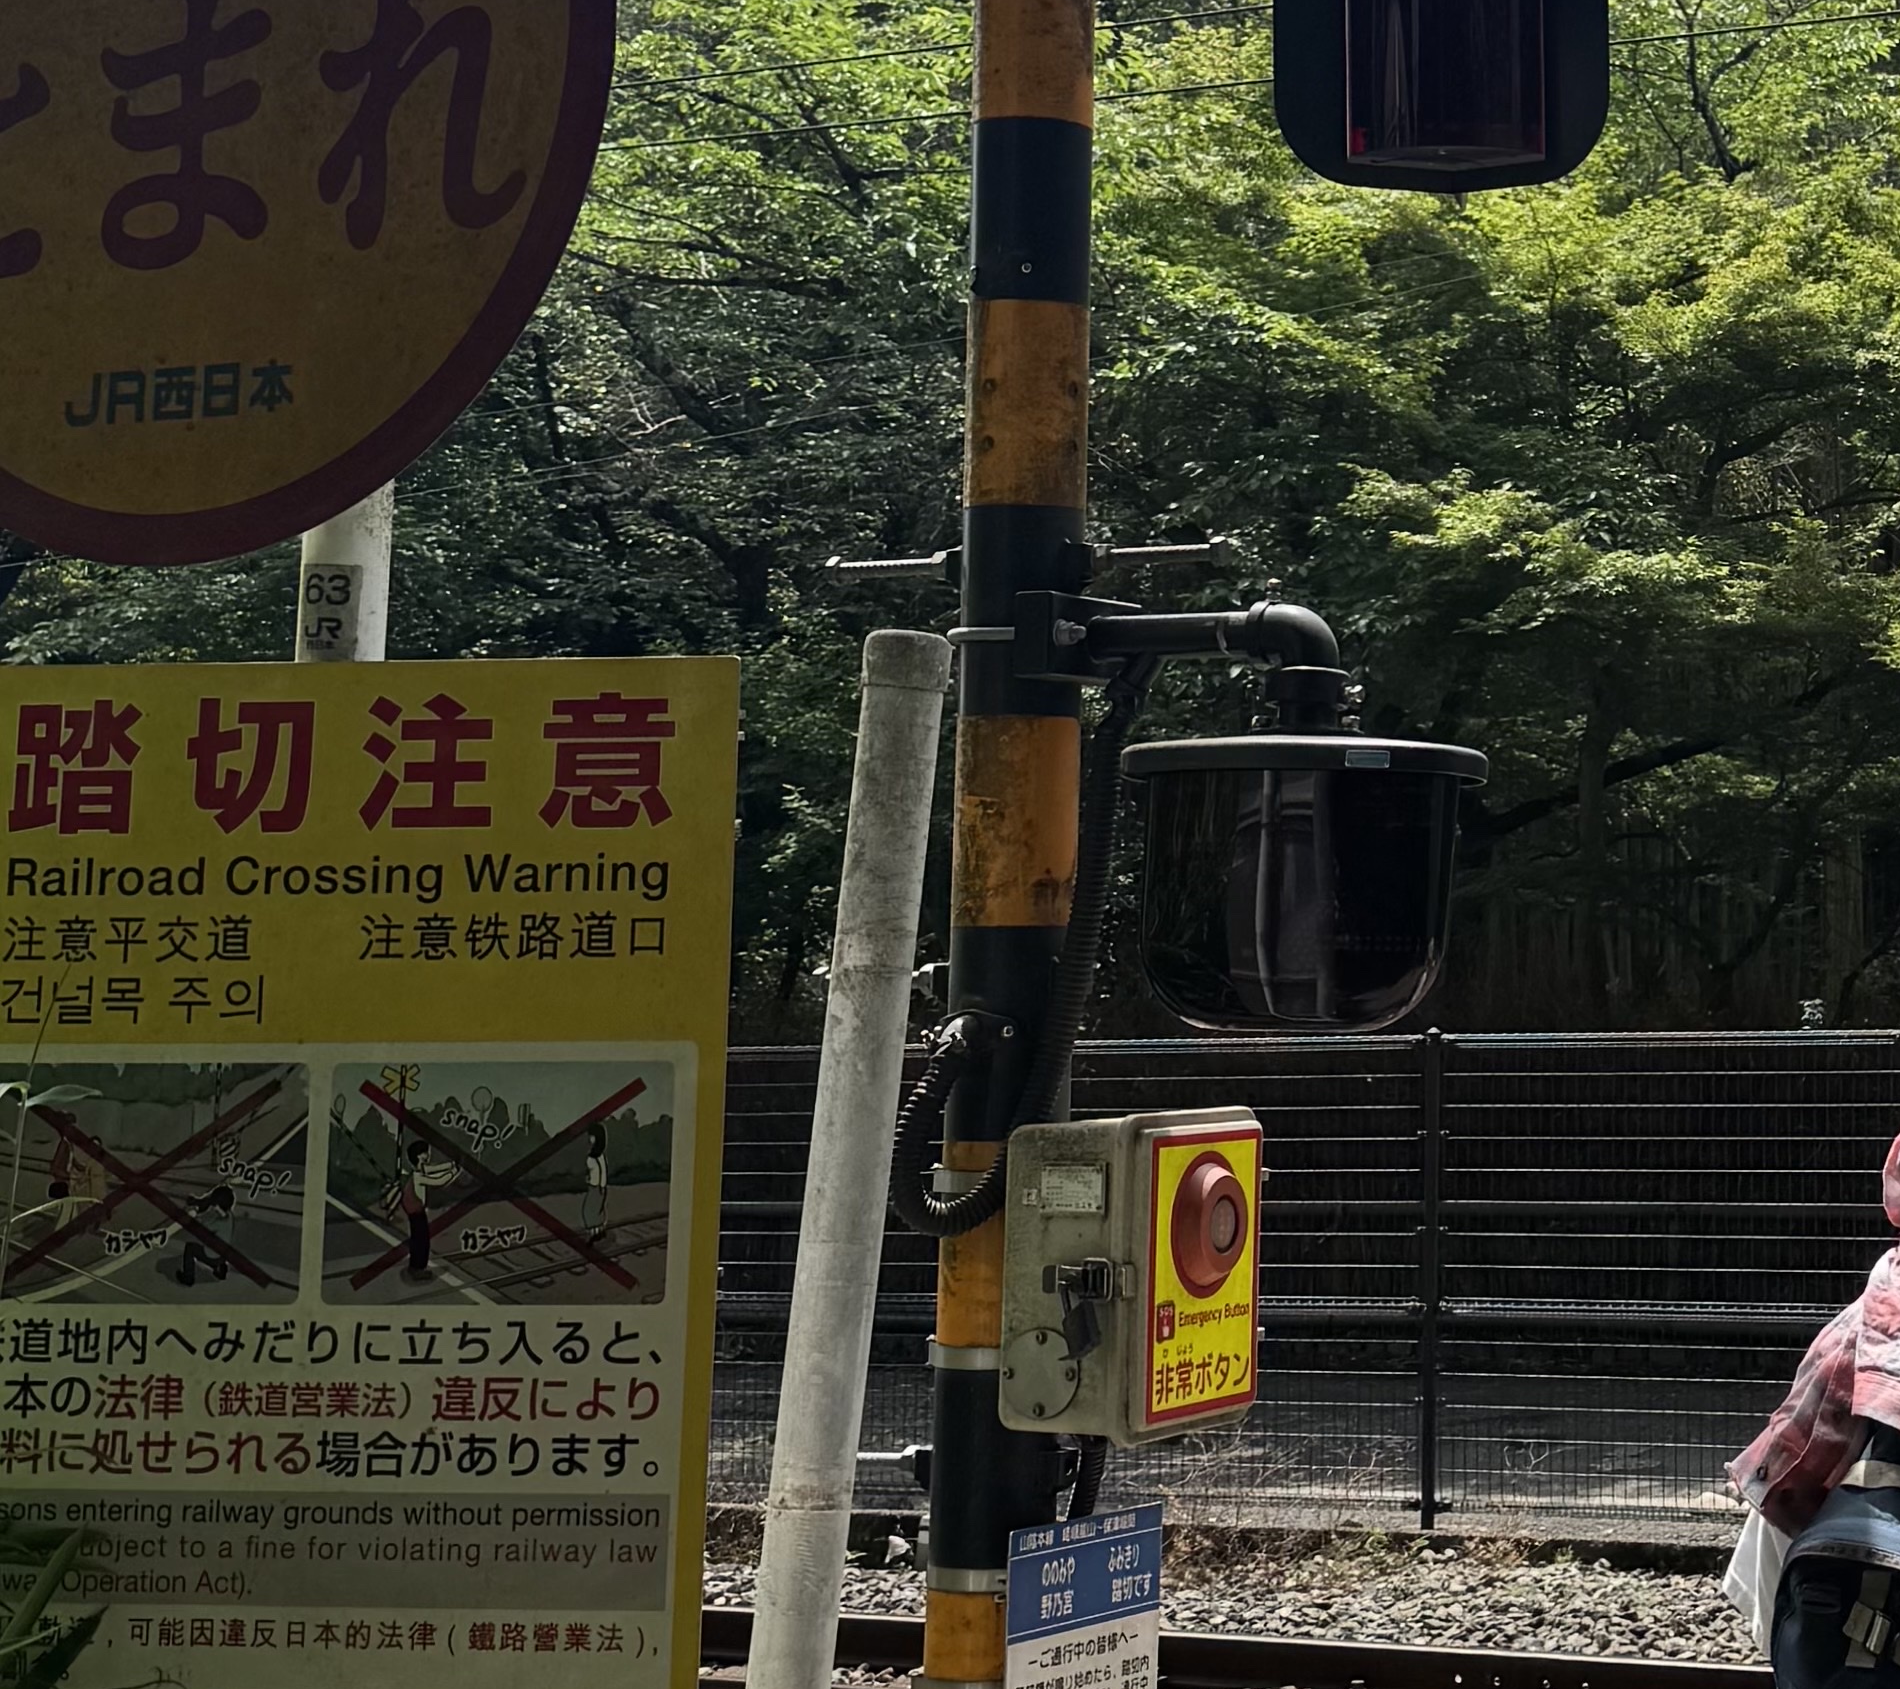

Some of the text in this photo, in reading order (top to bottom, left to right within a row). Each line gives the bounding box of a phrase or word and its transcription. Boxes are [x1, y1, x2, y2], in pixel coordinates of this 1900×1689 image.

[65, 364, 293, 428] JR西日本
[306, 574, 350, 605] 63
[305, 617, 342, 639] JR
[8, 693, 676, 835] 踏切注意
[7, 852, 669, 903] Railroad Crossing Warning
[3, 912, 665, 963] 注意平交道 注意铁路道口
[1, 974, 264, 1025] 건널목 주의
[442, 1110, 515, 1152] snap!
[219, 1158, 291, 1199] snap!
[1179, 1309, 1223, 1327] Emergency
[1156, 1351, 1250, 1406] 非常ボタン
[0, 1427, 659, 1478] 料に処せられる場合があります。
[66, 1498, 171, 1528] entering
[182, 1499, 274, 1529] railway
[284, 1500, 393, 1530] grounds
[404, 1502, 501, 1526] without
[512, 1503, 660, 1531] permission
[79, 1534, 167, 1561] ubject
[180, 1535, 206, 1558] to
[218, 1540, 233, 1559] a
[246, 1534, 295, 1560] fine
[309, 1535, 346, 1560] for
[359, 1537, 481, 1567] violating
[494, 1538, 597, 1569] railway
[609, 1539, 658, 1563] law
[1041, 1543, 1140, 1587] ののみや ふみきり
[61, 1569, 186, 1599] Operation
[195, 1570, 252, 1599] Act).
[1040, 1571, 1153, 1621] 野乃宮 踏切です
